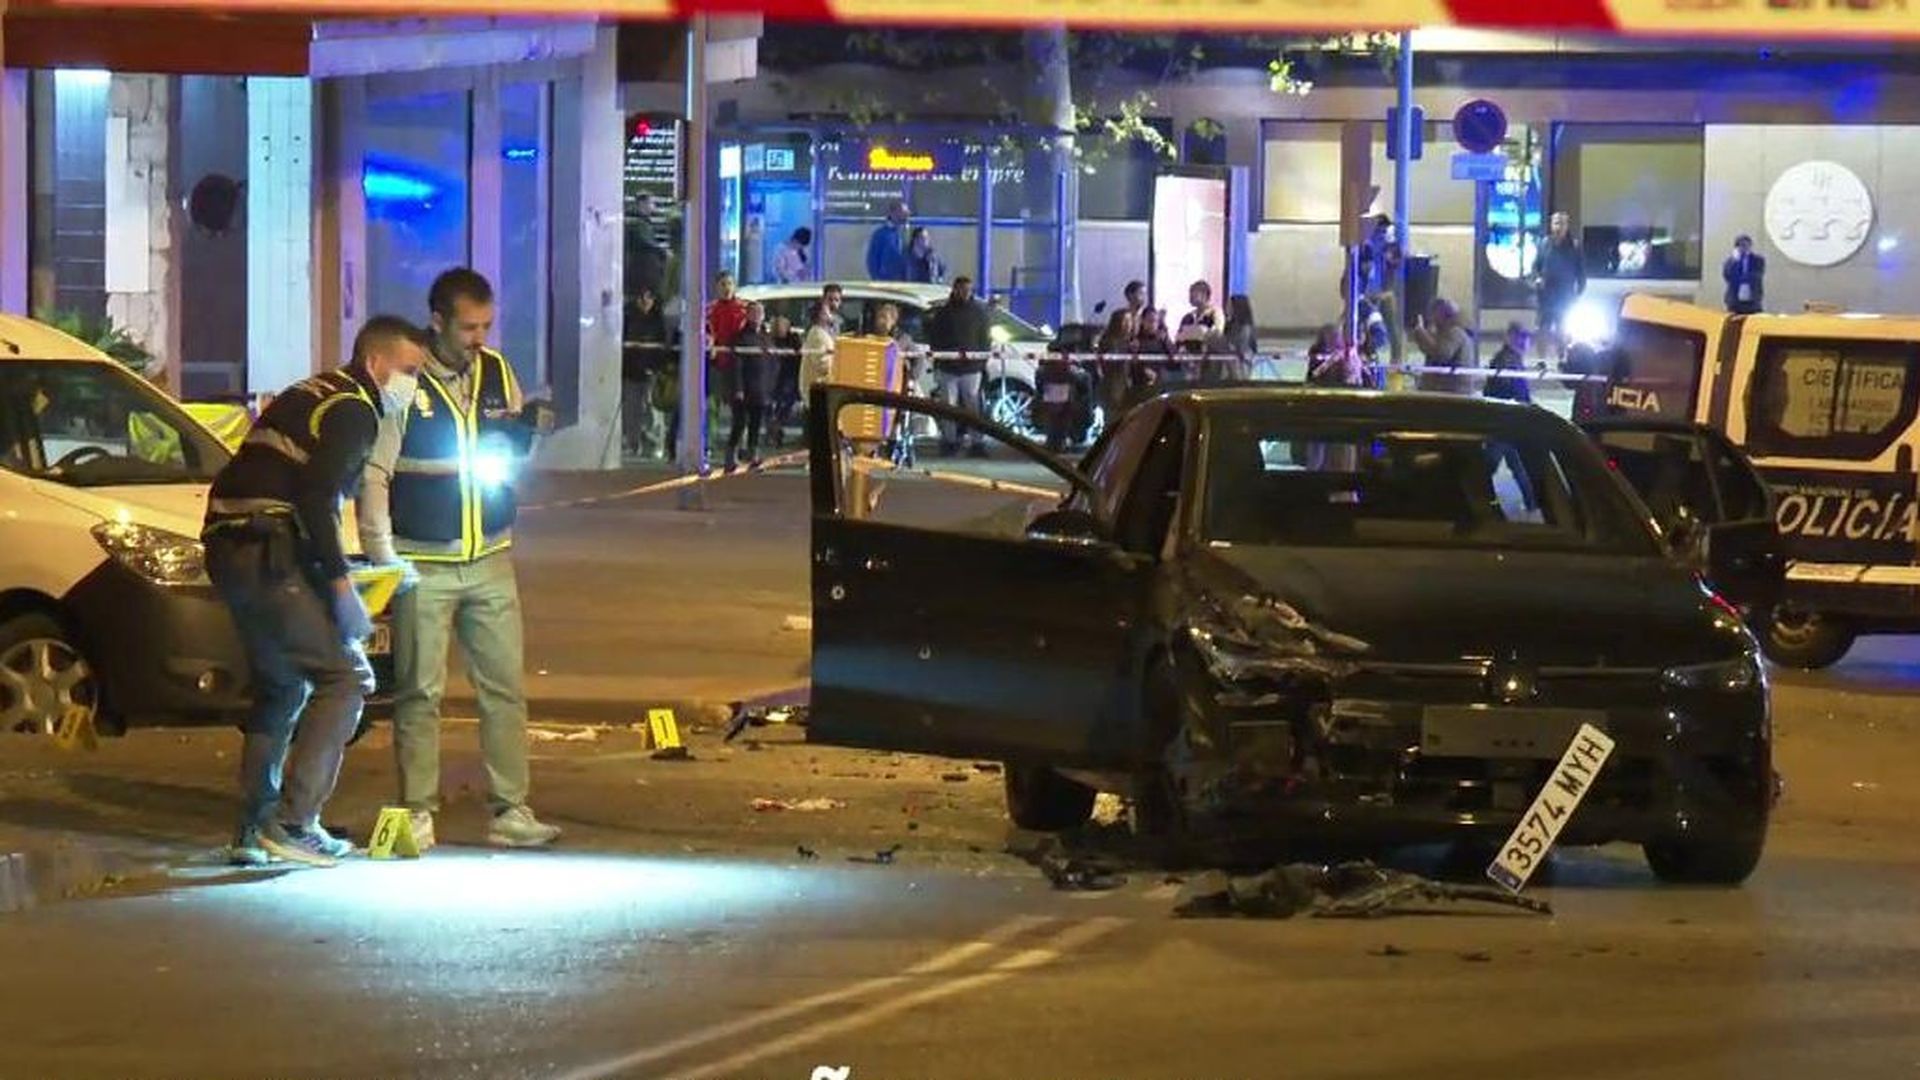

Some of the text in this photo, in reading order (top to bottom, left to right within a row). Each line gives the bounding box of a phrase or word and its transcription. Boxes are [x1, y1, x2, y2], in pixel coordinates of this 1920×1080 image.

[1803, 367, 1901, 390] CIETIFICA
[1607, 386, 1660, 413] ICIA
[1776, 493, 1918, 542] OLICÍA
[657, 715, 669, 739] 1
[1507, 735, 1606, 870] 3574 MYH
[377, 818, 391, 847] 6
